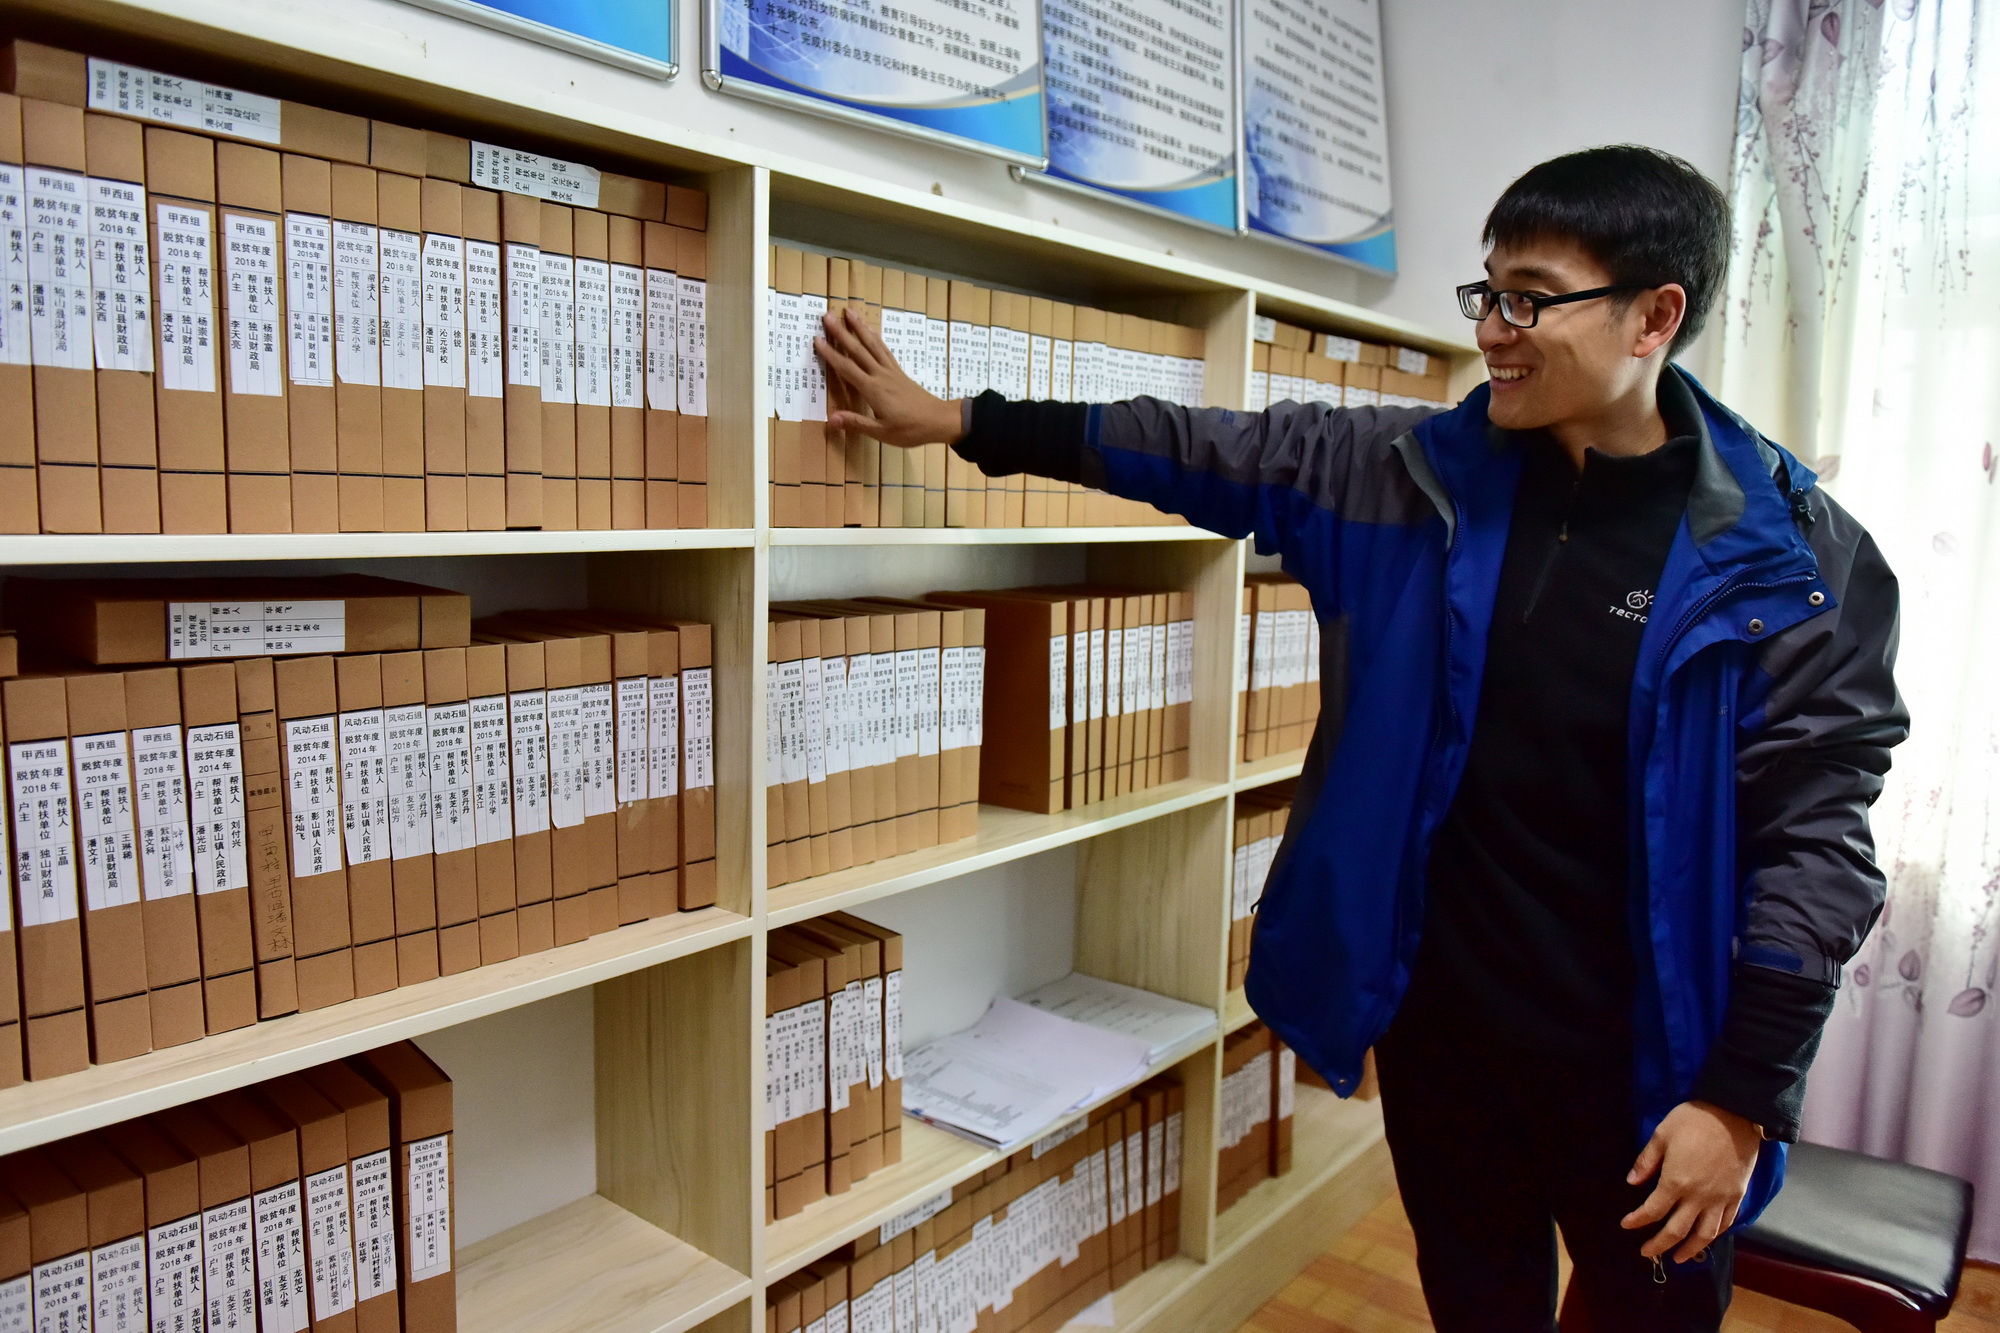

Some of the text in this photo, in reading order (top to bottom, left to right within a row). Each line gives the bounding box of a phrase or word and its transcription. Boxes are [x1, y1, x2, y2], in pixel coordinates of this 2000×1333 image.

[96, 70, 107, 100] 甲西组
[119, 70, 128, 110] 脱贫年度
[135, 76, 144, 110] 2018年
[153, 76, 183, 90] 帮扶人
[153, 92, 192, 107] 帮扶单位
[153, 110, 172, 119] 户主
[516, 153, 538, 165] 帮扶人
[39, 177, 75, 192] 甲西组
[515, 168, 545, 181] 帮扶单位
[100, 187, 134, 201] 甲西组
[515, 182, 529, 192] 户主
[94, 207, 140, 223] 脱贫年度
[169, 212, 200, 226] 甲西组
[99, 223, 137, 236] 2018年
[163, 232, 206, 247] 脱贫年度
[236, 223, 265, 237] 甲西组
[94, 240, 106, 260] 户主
[168, 248, 203, 260] 2018年
[231, 242, 271, 256] 脱贫年度
[297, 250, 321, 259] 2015年
[431, 240, 455, 251] 甲西组
[473, 248, 493, 258] 甲西组
[114, 242, 127, 284] 帮扶单位
[134, 245, 145, 276] 帮扶人
[235, 258, 268, 269] 2018年
[427, 257, 460, 270] 脱贫年度
[469, 264, 497, 276] 脱贫年度
[546, 260, 567, 270] 甲西组
[164, 264, 174, 284] 户主
[199, 268, 209, 298] 帮扶人
[232, 273, 242, 292] 户主
[430, 270, 457, 281] 2018年
[472, 277, 494, 286] 2018年
[516, 271, 534, 279] 2020年
[182, 266, 192, 306] 帮扶单位
[248, 275, 258, 314] 帮扶单位
[264, 276, 274, 306] 帮扶人
[426, 284, 434, 301] 户主
[33, 285, 45, 317] 潘国光
[95, 291, 107, 322] 潘文西
[440, 286, 448, 321] 帮扶单位
[454, 288, 462, 314] 帮扶人
[115, 293, 128, 355] 独山县财政局
[163, 313, 174, 344] 潘文斌
[198, 317, 208, 346] 杨崇富
[321, 316, 329, 342] 杨崇富
[182, 315, 193, 365] 独山财政局
[231, 321, 241, 349] 李天亮
[263, 324, 273, 352] 杨崇富
[426, 327, 434, 353] 潘正昭
[454, 331, 462, 348] 徐锐
[249, 322, 259, 370] 独山财政局
[440, 329, 448, 364] 沁元学校
[213, 607, 240, 615] 帮扶人
[189, 614, 197, 646] 脱贫年度
[213, 626, 250, 634] 帮扶单位
[266, 624, 320, 632] 紫林山村委会
[213, 644, 230, 652] 户主
[473, 703, 504, 713] 风动石组
[292, 724, 329, 735] 风动石组
[344, 716, 379, 727] 风动石组
[474, 718, 504, 729] 脱贫年度
[193, 731, 234, 743] 风动石组
[477, 730, 502, 739] 2015年
[22, 749, 57, 760] 甲西组
[85, 740, 116, 751] 甲西组
[194, 748, 235, 761] 脱贫年度
[82, 758, 123, 771] 脱贫年度
[199, 762, 232, 774] 2014年
[297, 753, 327, 764] 2014年
[16, 766, 64, 781] 脱贫年度
[86, 772, 120, 783] 2018年
[325, 767, 334, 793] 帮扶人
[22, 781, 61, 794] 2018年
[195, 781, 204, 799] 户主
[212, 778, 223, 815] 帮扶单位
[230, 776, 240, 803] 帮扶人
[310, 769, 319, 804] 帮扶单位
[83, 792, 94, 809] 户主
[101, 789, 112, 824] 帮扶单位
[118, 787, 129, 813] 帮扶人
[434, 794, 443, 819] 华秀兰
[462, 790, 470, 814] 罗丹丹
[476, 785, 484, 809] 潘文江
[488, 783, 496, 814] 友芝小学
[18, 802, 30, 822] 户主
[39, 800, 50, 840] 帮扶单位
[57, 797, 68, 827] 帮扶人
[327, 809, 335, 835] 刘付兴
[231, 820, 241, 848] 刘付兴
[295, 814, 305, 840] 华灿飞
[196, 826, 206, 853] 潘光应
[311, 812, 322, 873] 影山镇人民政府
[58, 846, 68, 866] 王晶
[87, 839, 98, 865] 潘文才
[214, 823, 226, 887] 影山镇人民政府
[19, 851, 31, 882] 潘光金
[104, 837, 118, 889] 独山县财政局
[40, 849, 54, 899] 独山财政局
[415, 1140, 442, 1152] 风动石组
[418, 1161, 439, 1170] 2018年
[259, 1188, 296, 1207] 风动石组
[259, 1204, 297, 1224] 脱贫年度
[264, 1217, 294, 1233] 2018年
[261, 1240, 270, 1257] 户主
[276, 1234, 286, 1268] 帮扶单位
[291, 1229, 300, 1255] 帮扶人
[39, 1259, 84, 1279] 风动石组
[315, 1260, 323, 1282] 华中安
[279, 1275, 289, 1308] 友芝小学
[294, 1269, 303, 1294] 龙加文
[44, 1291, 81, 1309] 2018年
[264, 1279, 273, 1306] 刘炳莲
